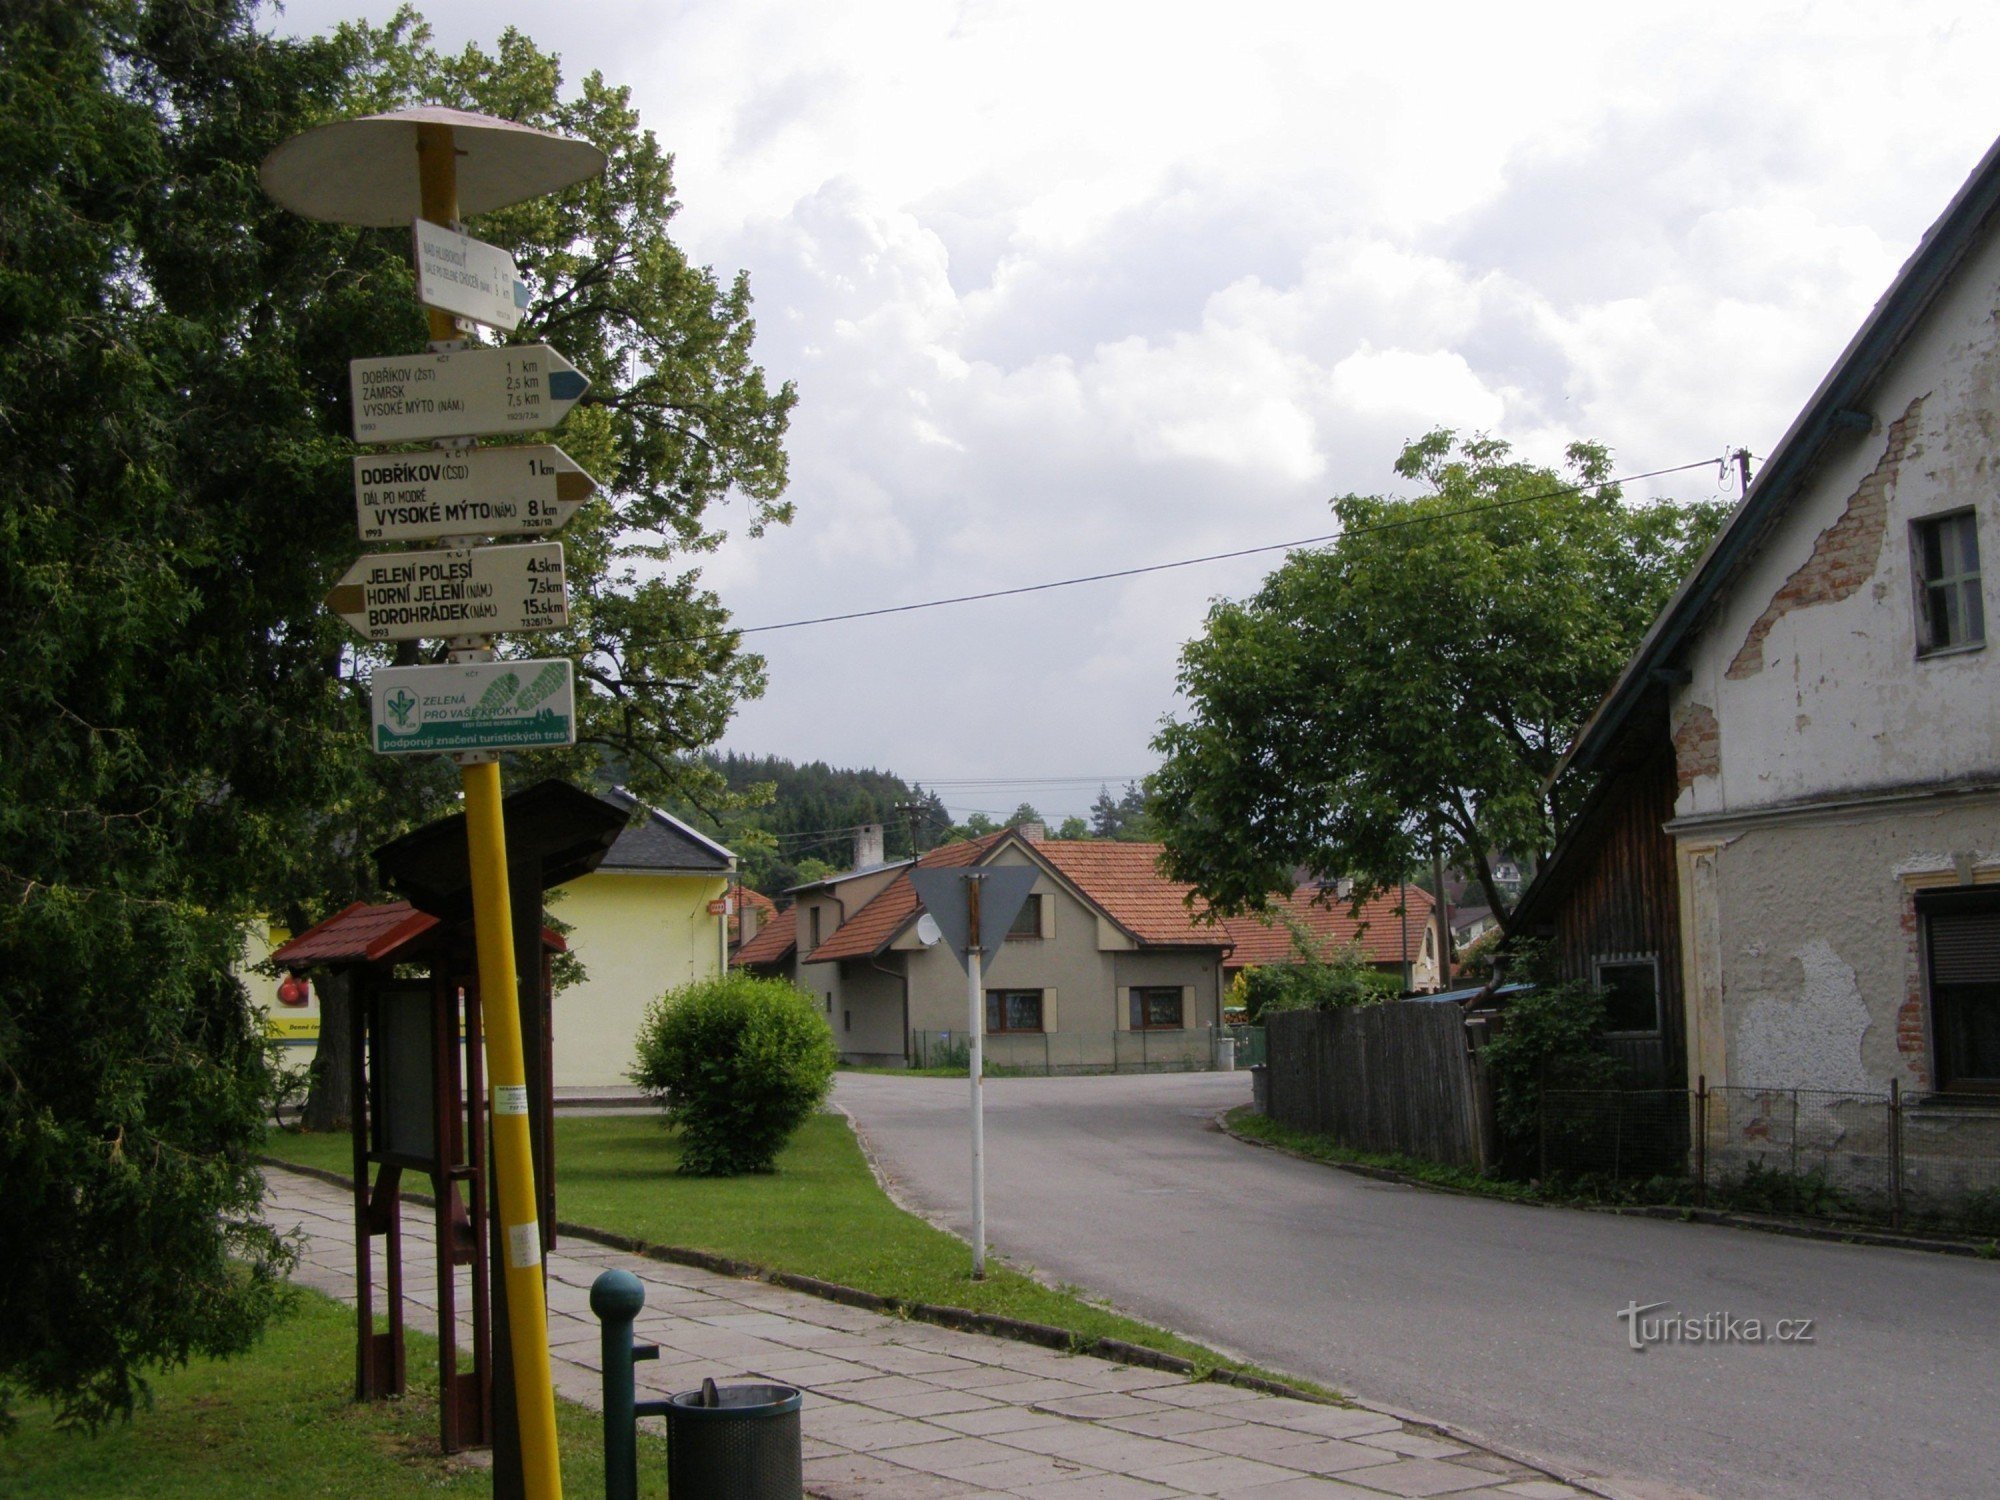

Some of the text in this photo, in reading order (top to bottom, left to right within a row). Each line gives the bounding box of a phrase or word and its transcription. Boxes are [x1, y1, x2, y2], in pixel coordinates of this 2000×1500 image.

[362, 367, 436, 385] DOBŘÍKOV (ŽST)
[507, 361, 538, 374] 1 km
[363, 383, 405, 401] ZÁMRSK
[507, 376, 539, 391] 2,5 km
[363, 398, 465, 417] VYSOKÉ MÝTO (NÁM.)
[524, 393, 540, 405] km
[361, 463, 469, 485] DOBŘÍKOV (ČSD)
[529, 459, 555, 476] 1 km
[364, 487, 427, 506] DÁL PO MODRÉ
[375, 502, 442, 526] VYSOKÉ
[445, 500, 490, 521] MÝTO
[528, 500, 557, 516] 8 km
[365, 529, 382, 538] 1993
[367, 559, 473, 585] JELENÍ POLESÍ
[367, 583, 410, 606] HORNÍ
[414, 580, 465, 602] JELENÍ
[369, 602, 470, 626] BOROHRÁDEK
[370, 628, 389, 637] 1993
[423, 693, 466, 706] ZELENÁ
[424, 706, 519, 719] PRO VAŠE KROKY
[383, 731, 565, 749] podporují značení turistických tras
